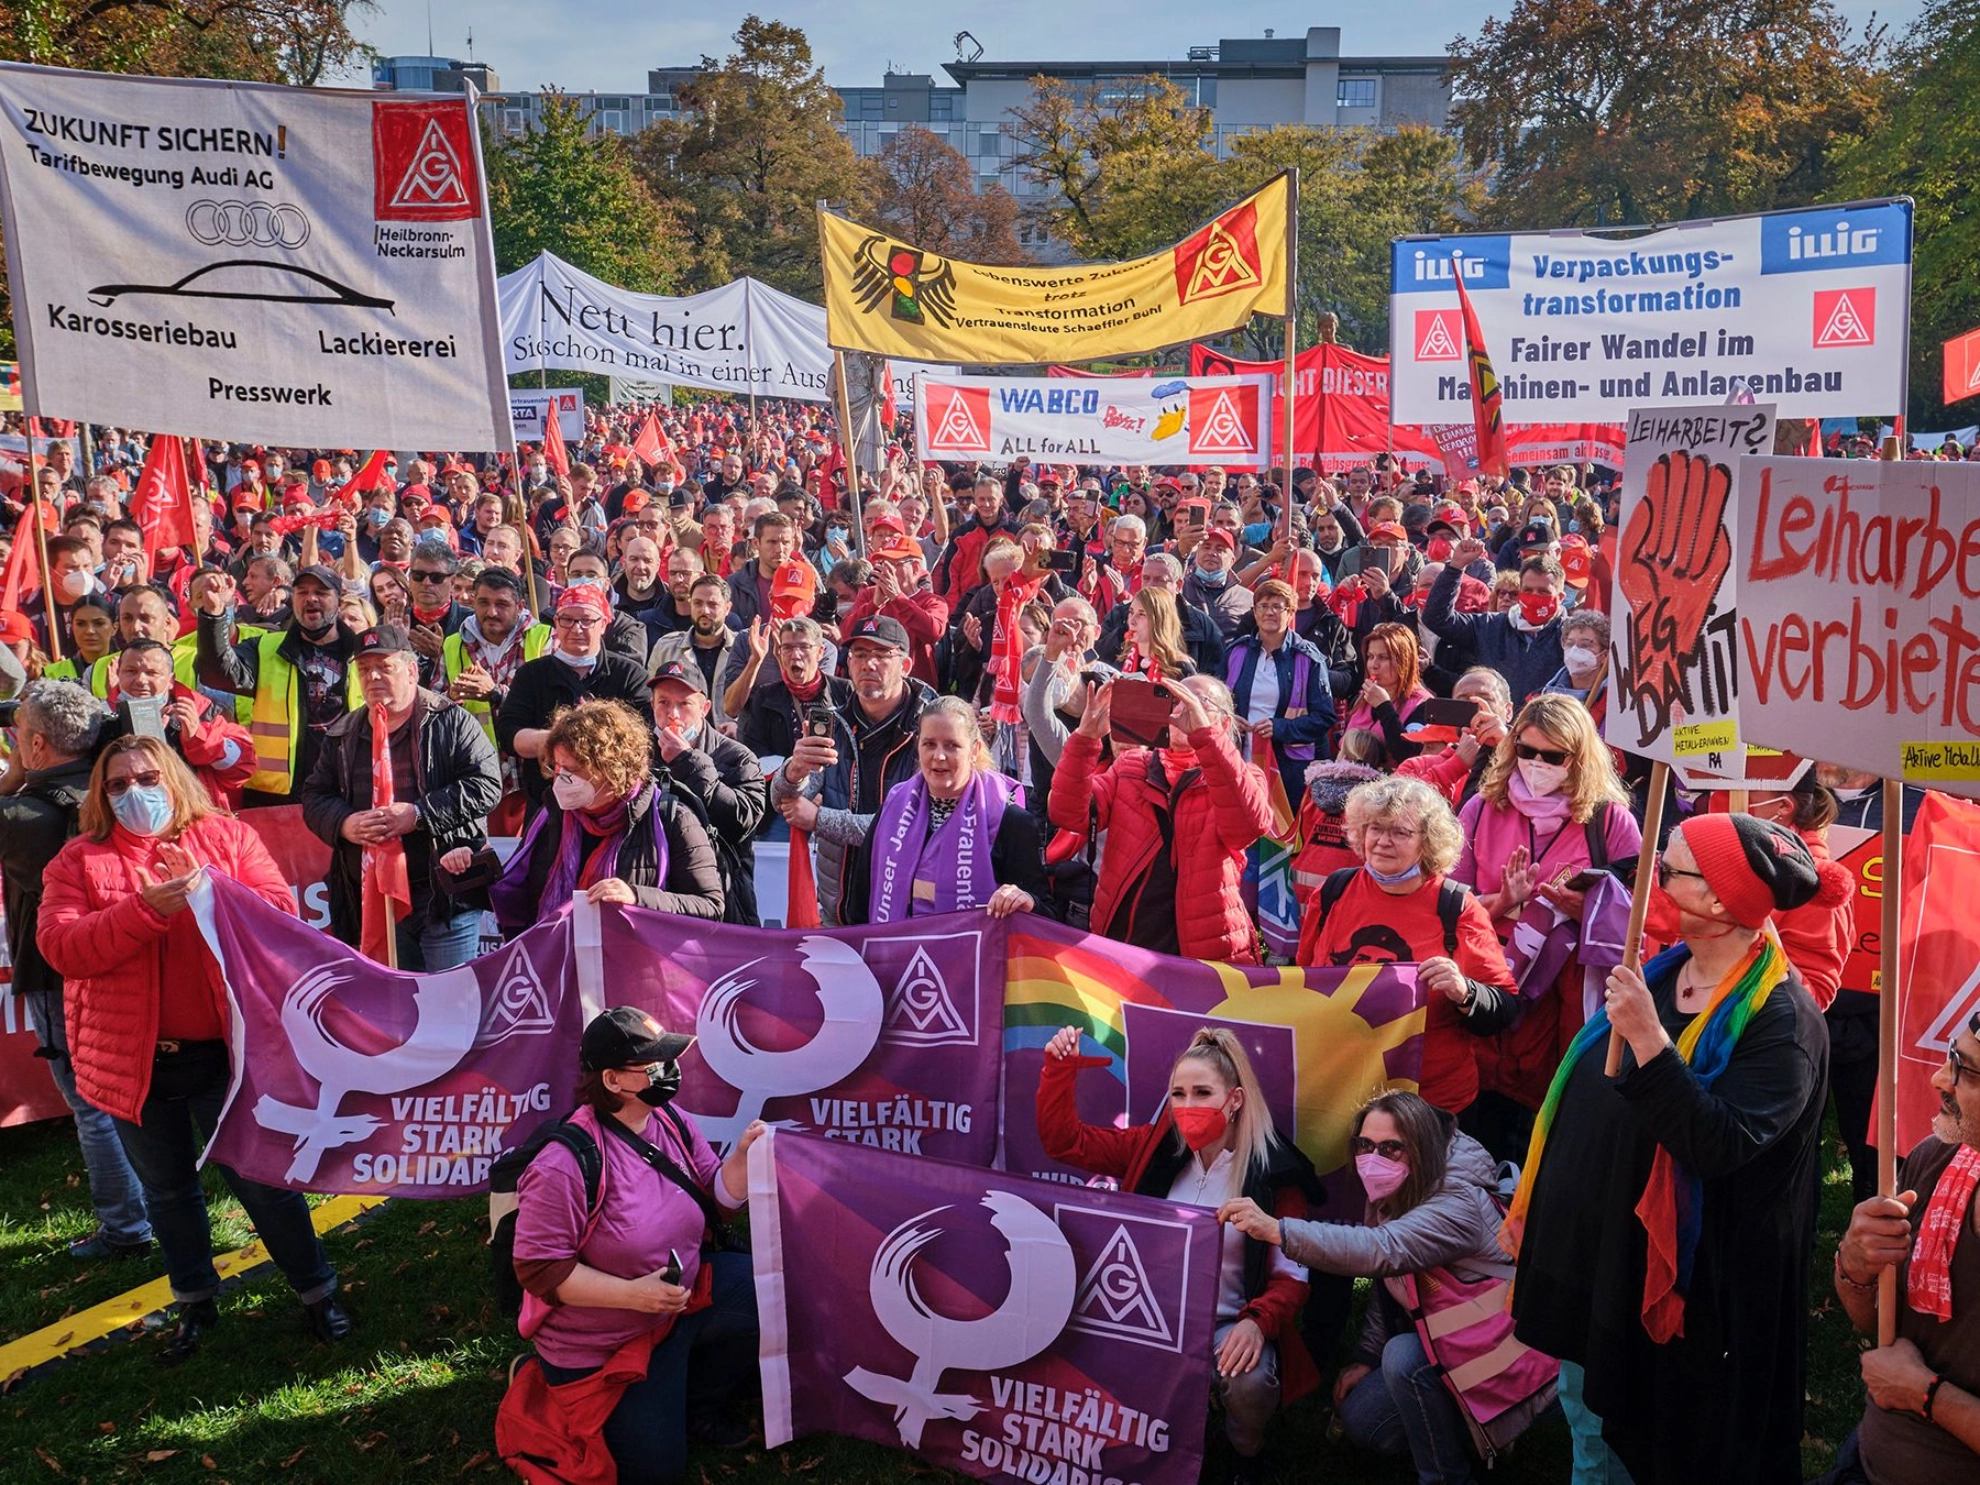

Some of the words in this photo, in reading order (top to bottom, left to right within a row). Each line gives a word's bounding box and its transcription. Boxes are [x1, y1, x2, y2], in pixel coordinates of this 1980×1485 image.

[23, 108, 151, 150] ZUKUNFT
[158, 125, 287, 160] SICHERN!
[26, 144, 185, 189] Tarifbewegung
[190, 166, 240, 188] Audi
[244, 169, 275, 190] AG
[377, 243, 466, 259] Neckarsulm
[1532, 249, 1734, 280] Verpackungs-
[539, 280, 636, 339] Nett
[651, 310, 745, 352] hier.
[1522, 280, 1742, 317] transformation
[47, 303, 237, 349] Karosseriebau
[955, 316, 1060, 334] Vertrauensleute
[1063, 315, 1130, 334] Schaeffler
[317, 329, 458, 359] Lackiererei
[1510, 334, 1591, 364] Fairer
[1600, 331, 1707, 360] Wandel
[1717, 327, 1755, 357] im
[625, 350, 670, 373] mal
[678, 356, 702, 377] in
[711, 358, 773, 383] einer
[208, 377, 333, 406] Presswerk
[1000, 387, 1100, 415] WABCO
[1438, 371, 1590, 401] Mahinen-
[1599, 370, 1658, 398] und
[1000, 437, 1037, 455] ALL
[1041, 437, 1063, 454] for
[1065, 437, 1101, 455] ALL
[1629, 411, 1770, 455] LEIHARBEIT?
[876, 855, 898, 925] Unser
[391, 1082, 551, 1125] VIELFÄLTIG
[809, 1093, 973, 1135] VIELFÄLTIG
[402, 1122, 505, 1156] STARK
[990, 1376, 1170, 1453] VIELFÄLTIG
[1002, 1413, 1108, 1472] STARK
